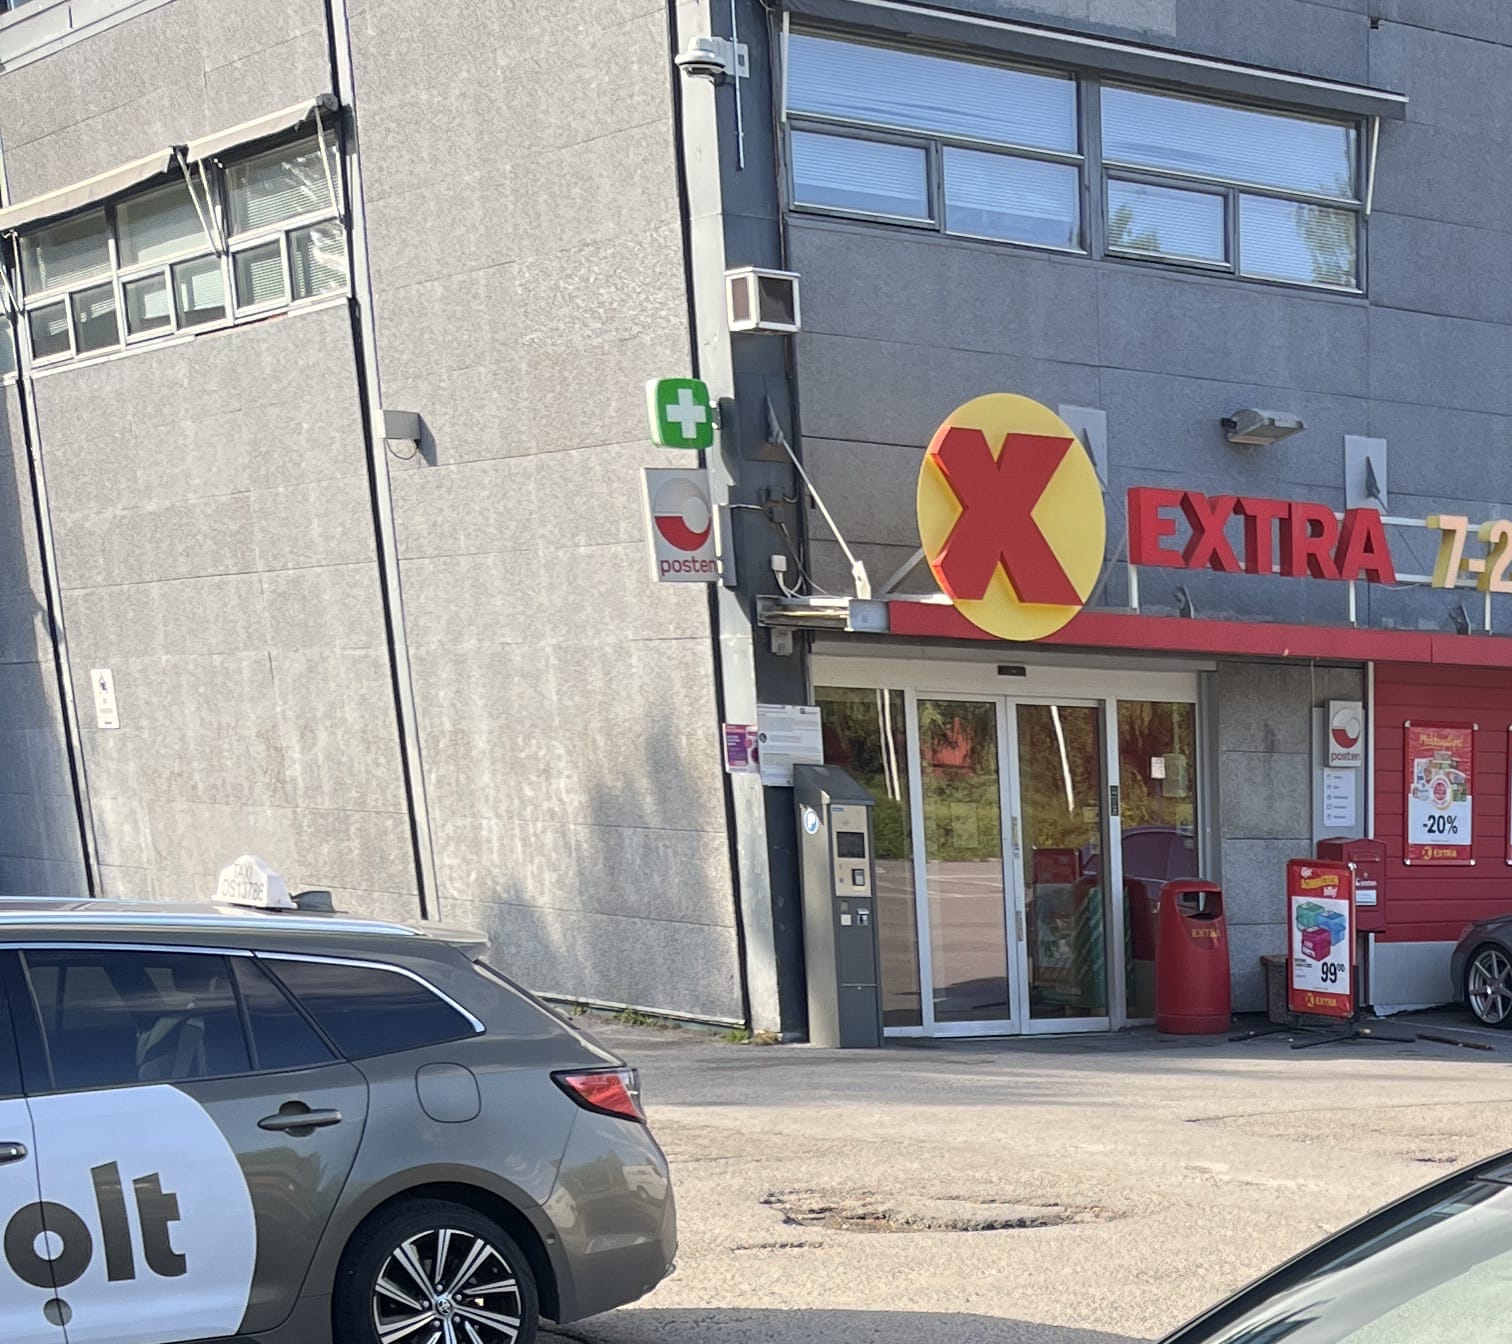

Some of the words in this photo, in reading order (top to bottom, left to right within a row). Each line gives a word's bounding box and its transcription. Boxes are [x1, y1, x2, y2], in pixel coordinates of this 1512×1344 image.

[1127, 487, 1397, 584] EXTRA
[660, 556, 718, 576] posten
[1331, 752, 1360, 763] posten
[1422, 815, 1458, 835] -20%
[1321, 962, 1338, 983] 99
